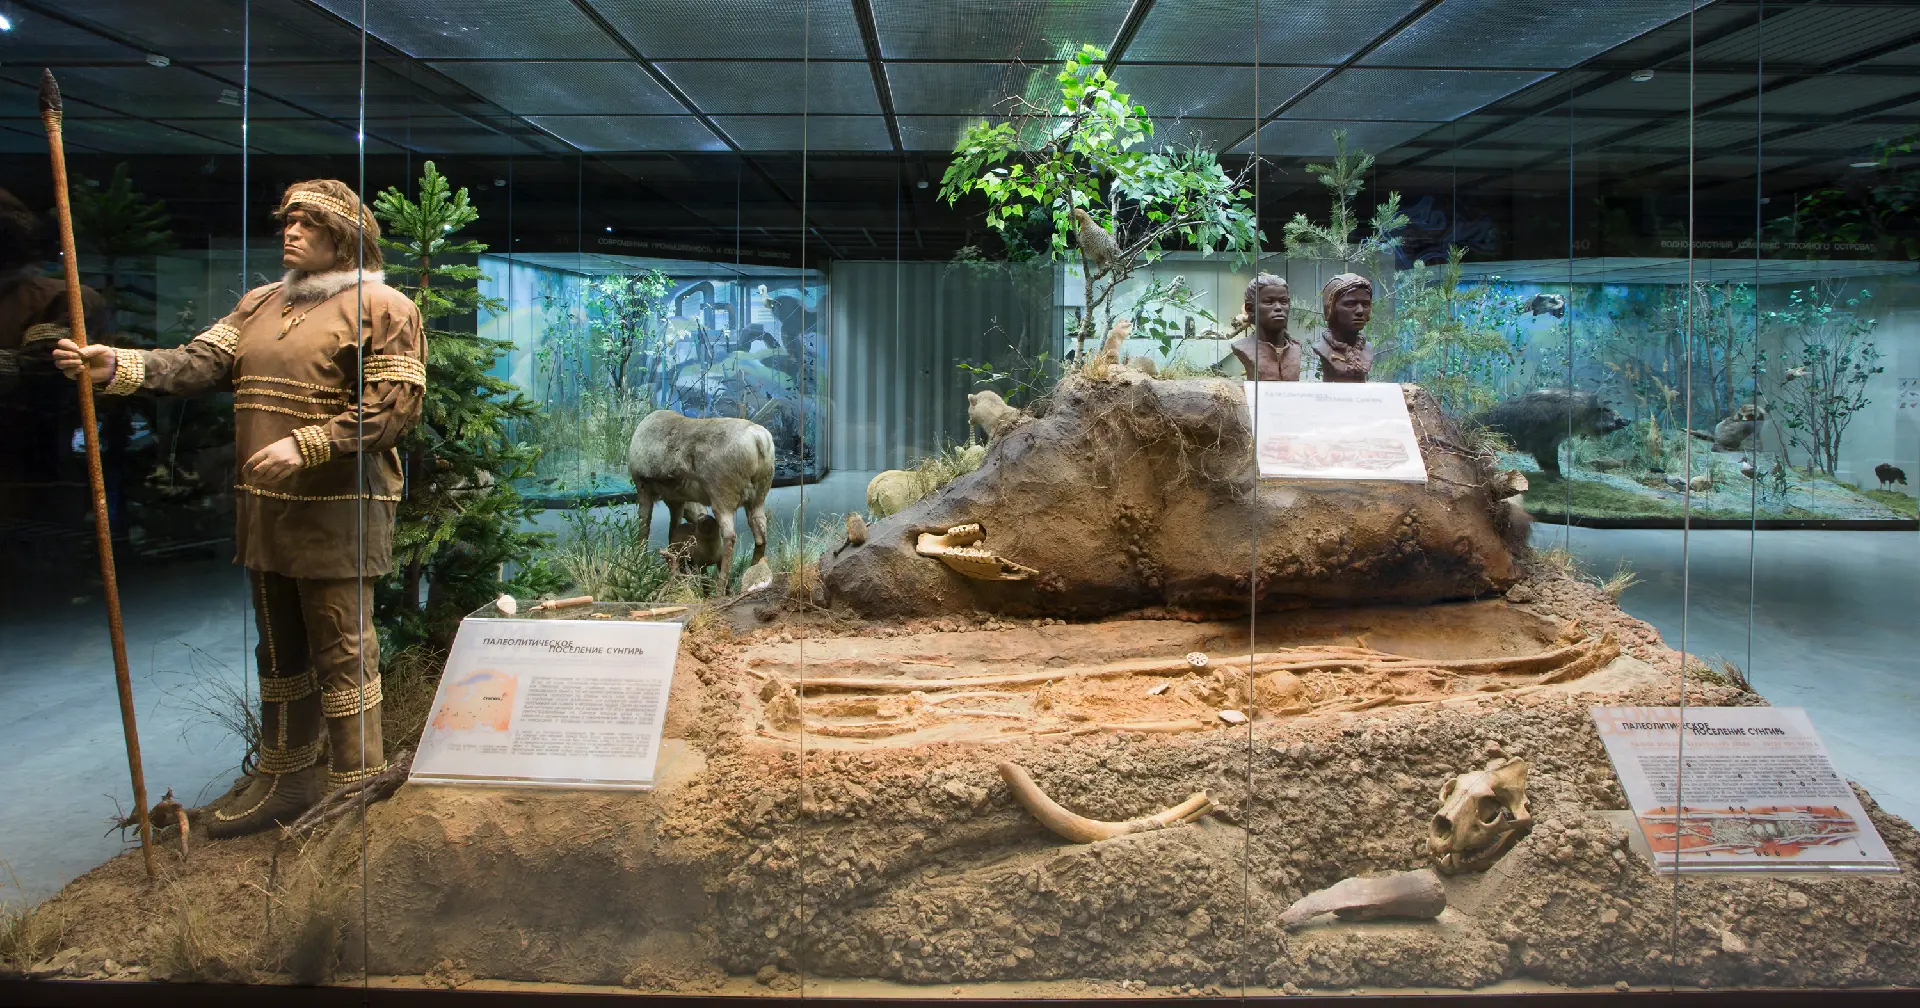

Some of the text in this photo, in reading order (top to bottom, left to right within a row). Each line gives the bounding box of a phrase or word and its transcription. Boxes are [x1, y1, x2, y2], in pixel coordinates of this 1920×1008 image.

[482, 638, 574, 647] ПАЛЕОЛИТИЧЕСКОЕ
[548, 644, 644, 656] ПОСЕЛЕНИЕ СУНГИРЬ
[1692, 727, 1786, 736] ПОСЕЛЕНИЕ СУНГИРЬ
